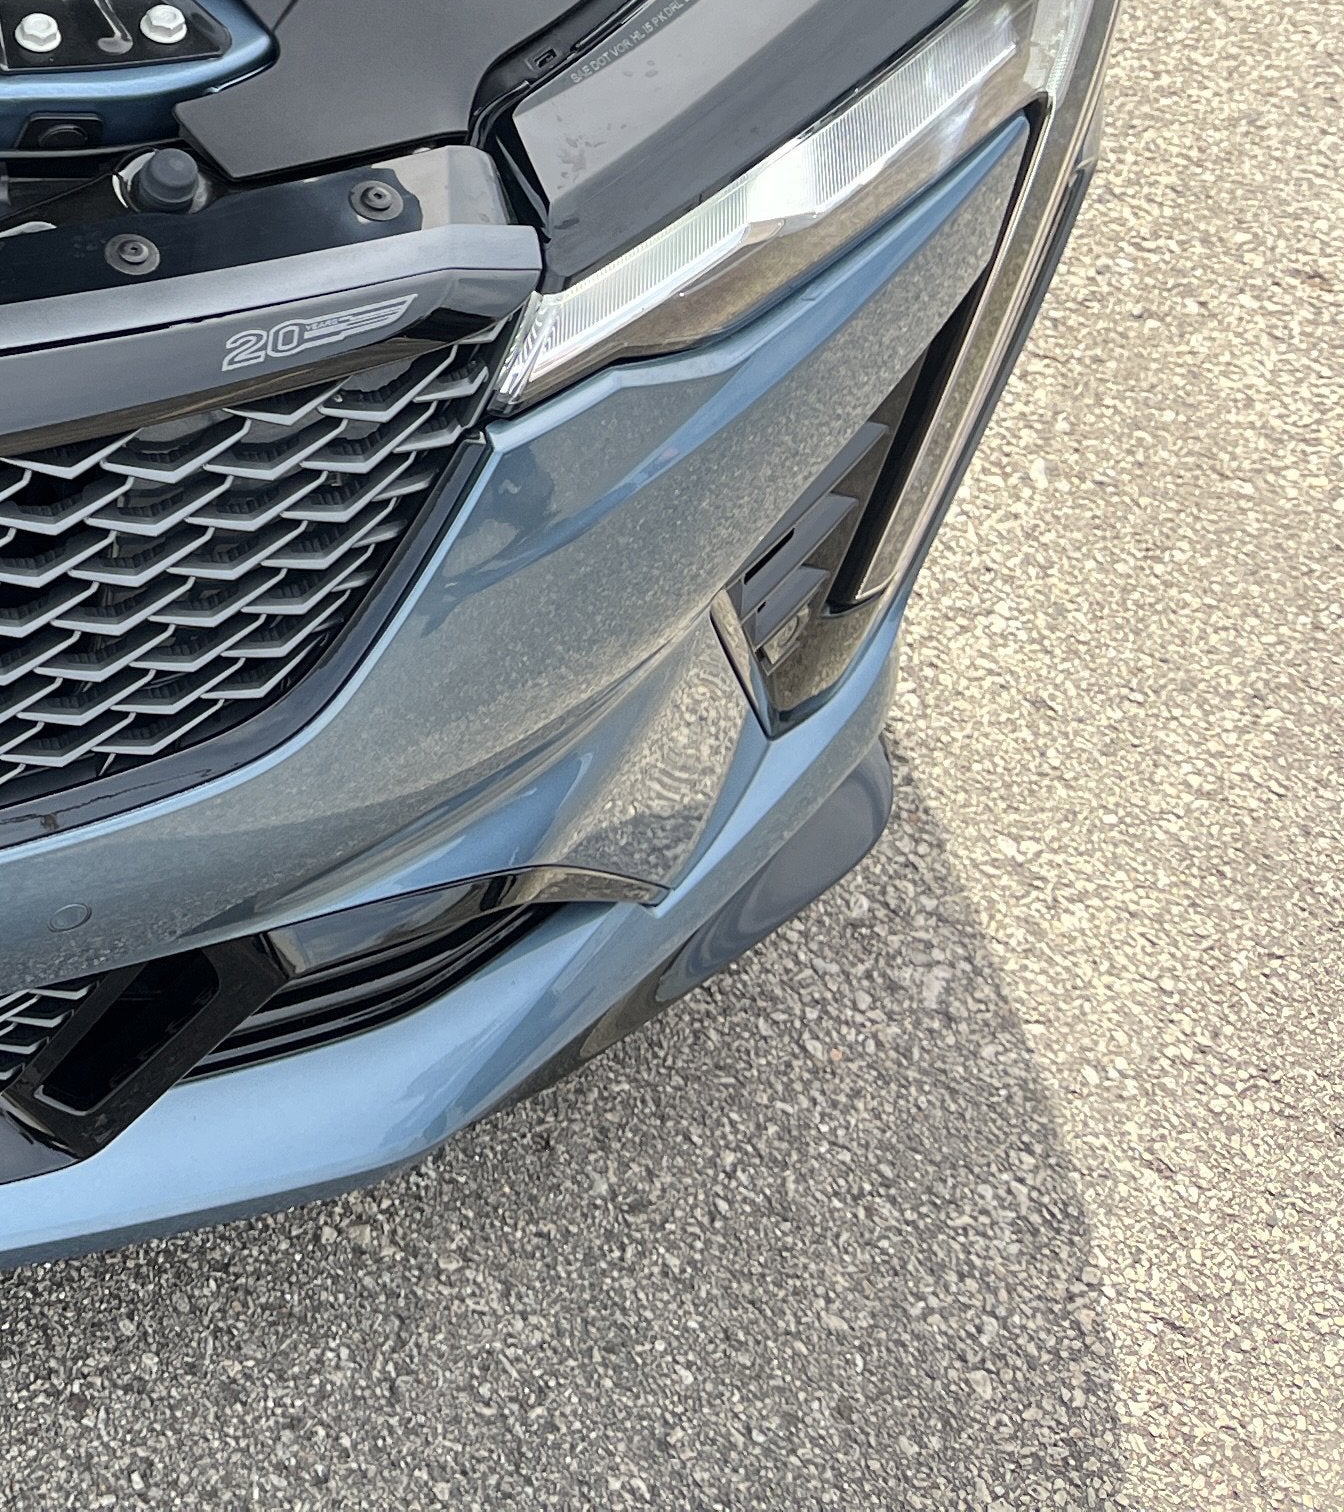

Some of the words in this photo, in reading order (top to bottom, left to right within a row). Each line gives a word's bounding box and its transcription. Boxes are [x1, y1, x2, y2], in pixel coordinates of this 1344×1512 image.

[570, 65, 592, 83] SAE
[589, 51, 612, 71] DOT
[609, 38, 633, 57] VOR
[221, 319, 303, 372] 20
[305, 318, 338, 331] YEARS
